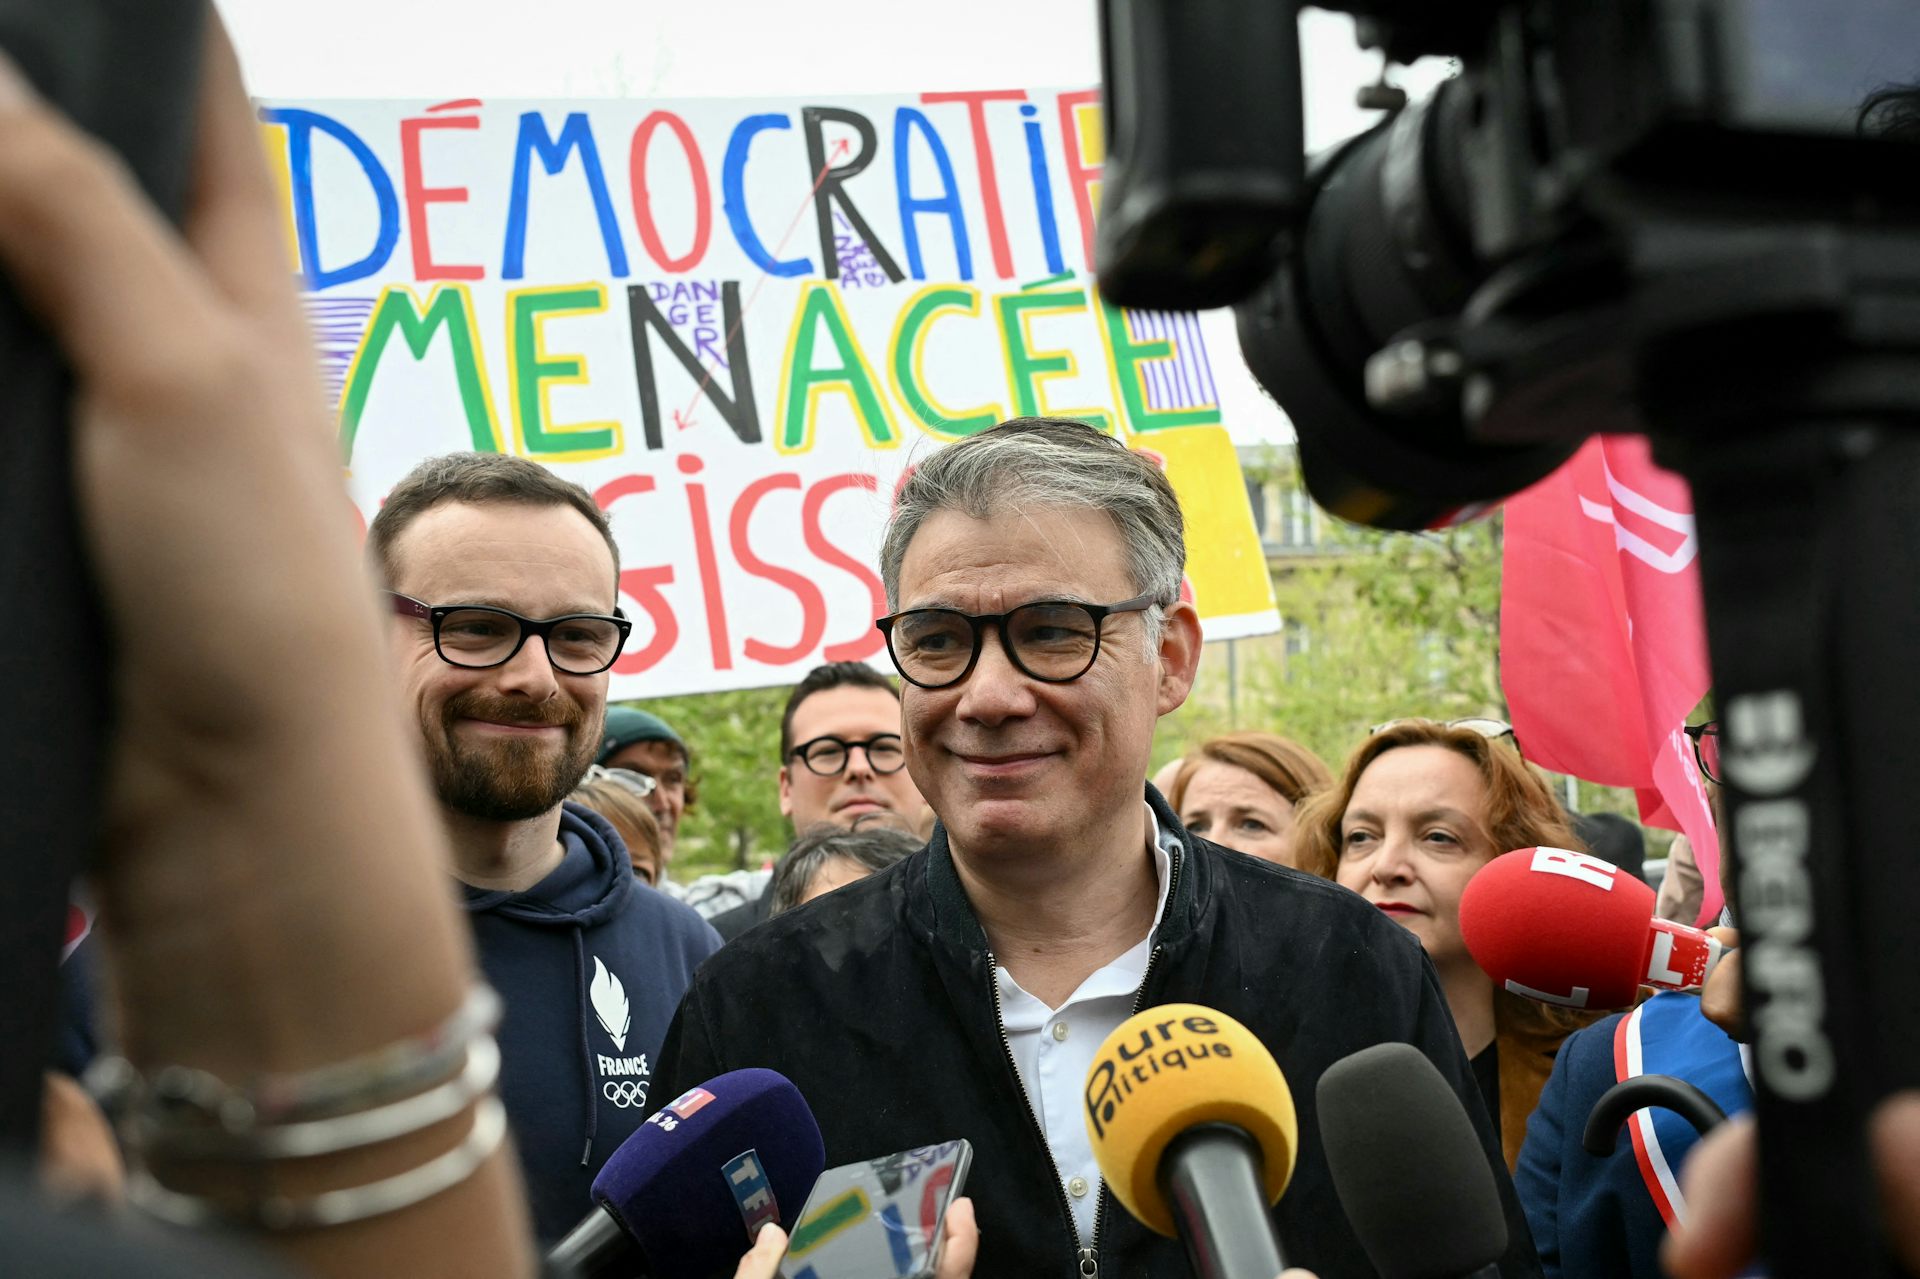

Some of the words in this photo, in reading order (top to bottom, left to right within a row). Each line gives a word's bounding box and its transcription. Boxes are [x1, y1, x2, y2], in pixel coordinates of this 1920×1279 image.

[336, 269, 1222, 468] MENACÉE
[597, 1053, 650, 1077] FRANCE
[657, 1116, 679, 1132] 26
